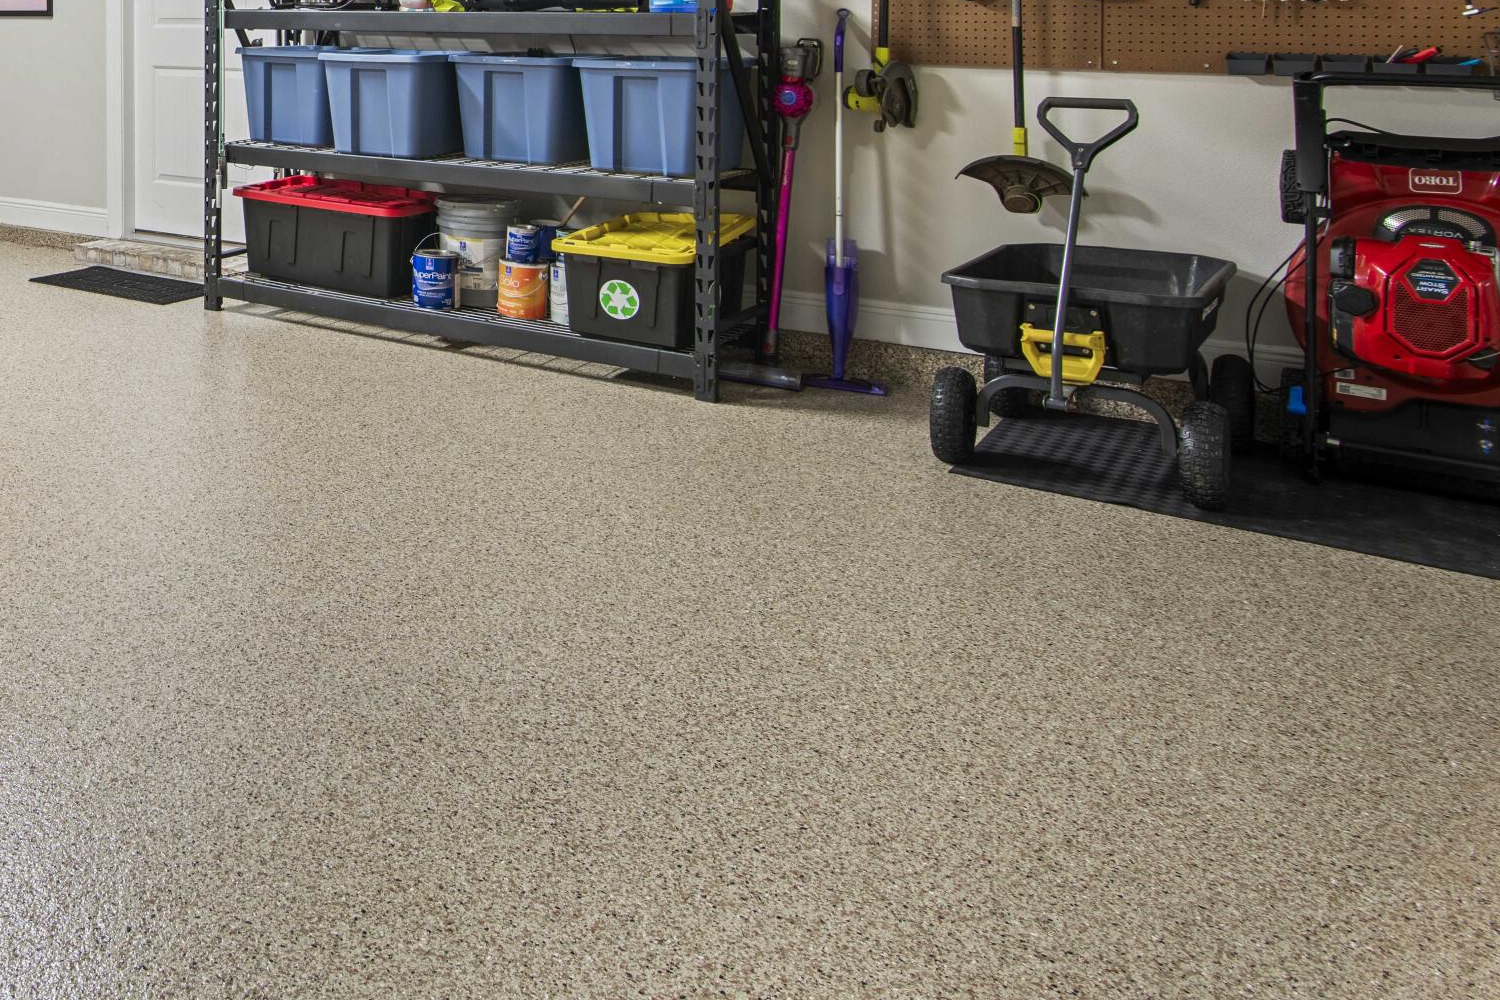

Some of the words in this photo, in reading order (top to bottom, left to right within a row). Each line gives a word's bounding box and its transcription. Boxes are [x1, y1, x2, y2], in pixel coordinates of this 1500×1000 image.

[1414, 175, 1457, 186] TORO
[1408, 227, 1464, 239] VORTEX
[1419, 280, 1446, 288] STOW
[1416, 285, 1449, 295] SMART
